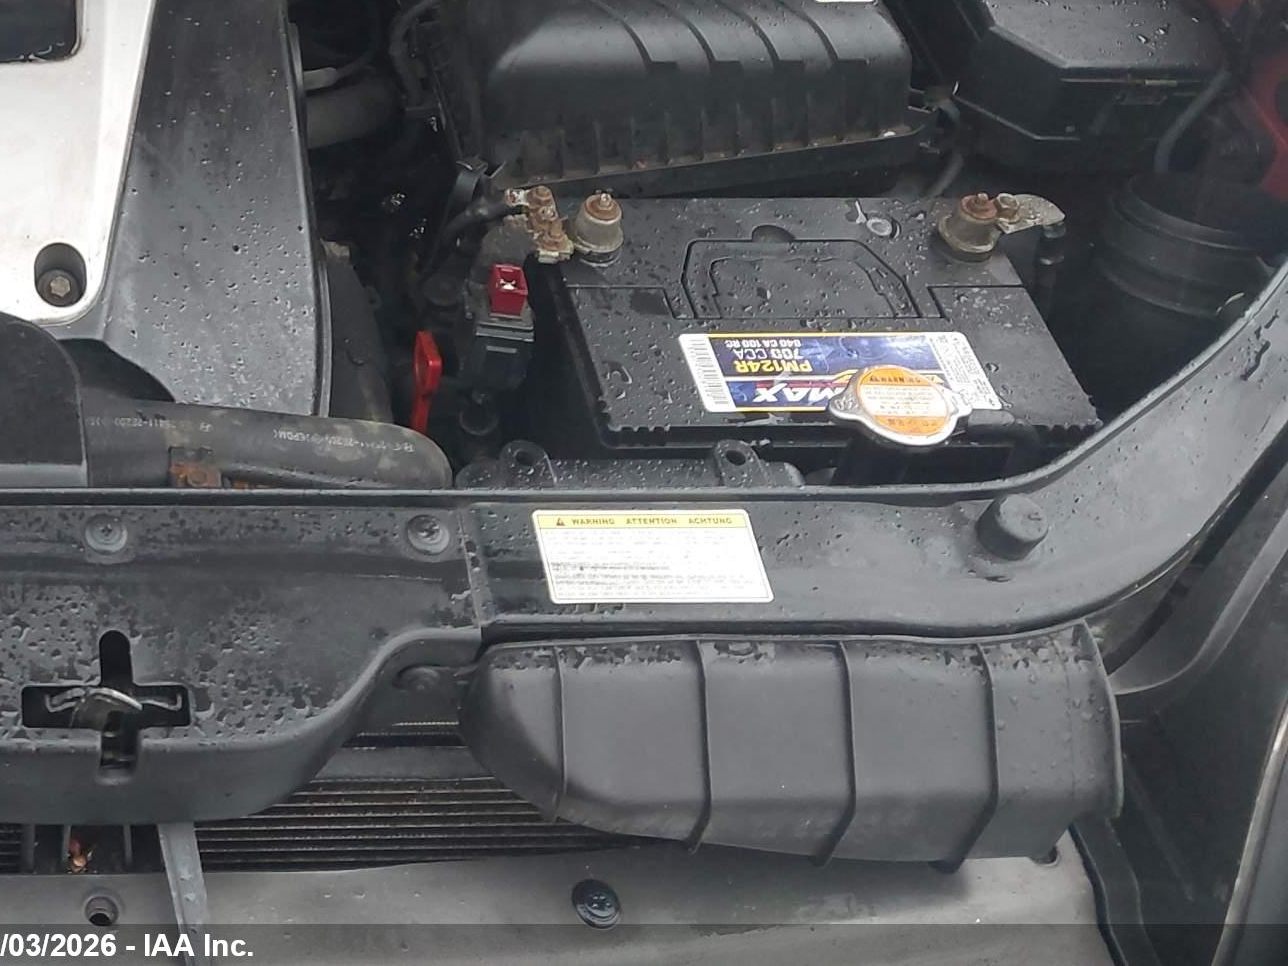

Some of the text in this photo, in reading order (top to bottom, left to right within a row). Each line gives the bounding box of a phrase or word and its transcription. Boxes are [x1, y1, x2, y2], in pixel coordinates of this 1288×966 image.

[732, 348, 768, 360] CCA
[733, 359, 813, 373] PM124R
[571, 517, 733, 525] WARNING ATTENTION ACHTUNG
